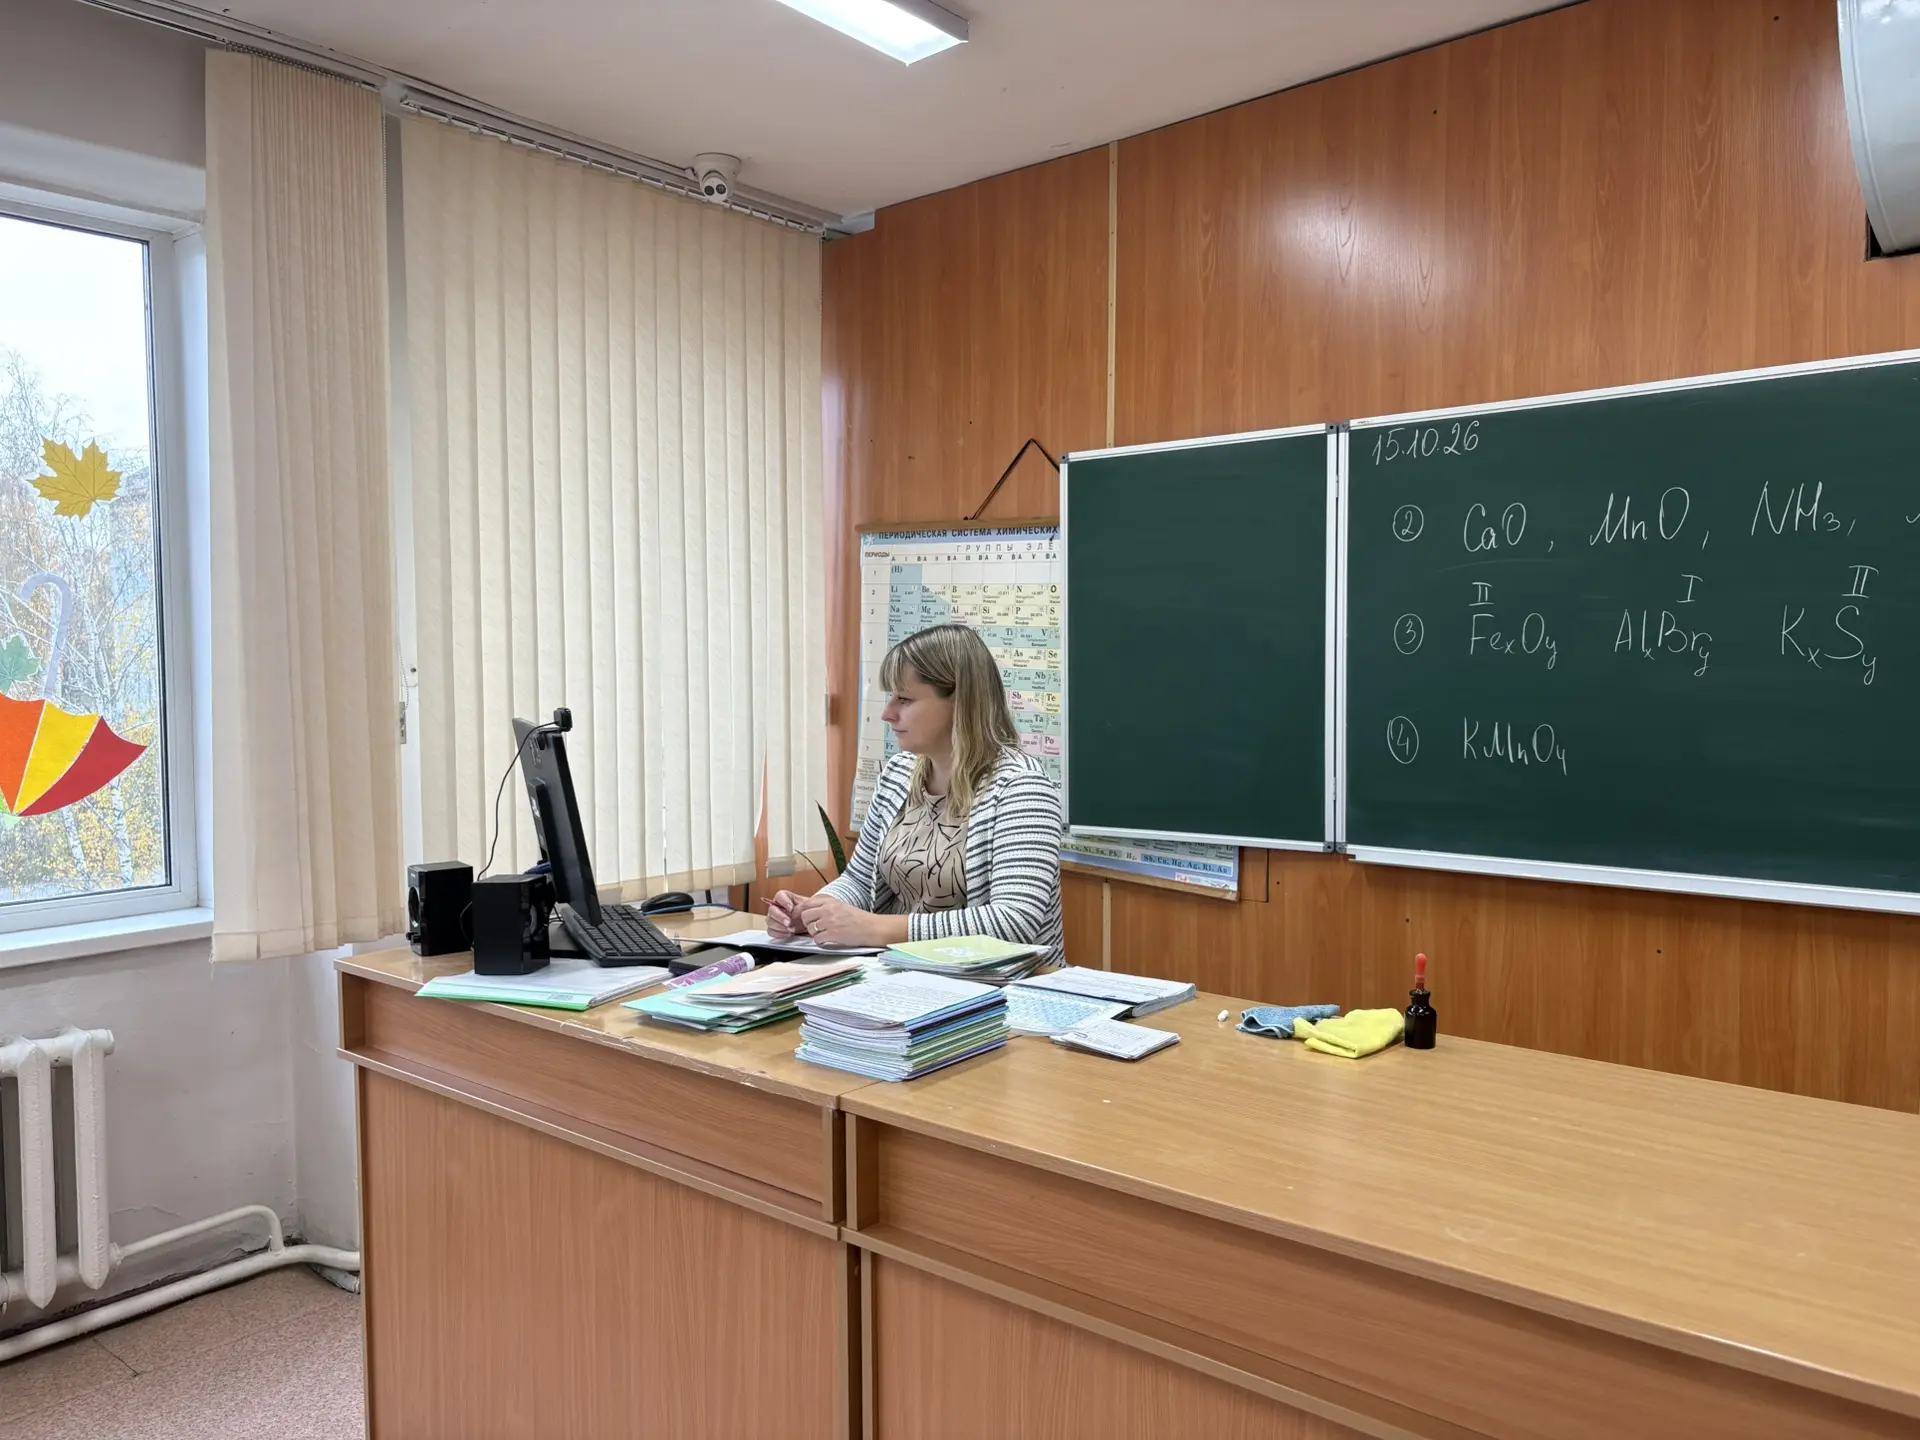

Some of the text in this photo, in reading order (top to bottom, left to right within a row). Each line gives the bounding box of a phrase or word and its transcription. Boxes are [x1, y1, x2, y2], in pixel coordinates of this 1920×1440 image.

[1371, 420, 1480, 466] 15.10.26
[878, 525, 1059, 541] ПЕРИОДИЧЕСКАЯ СИСТЕМА ХИМИЧЕСКИХ
[1050, 584, 1057, 593] O
[890, 605, 900, 613] Na
[920, 606, 931, 614] Mg
[952, 606, 959, 614] Al
[982, 606, 990, 614] Si
[1016, 606, 1021, 614] P
[1050, 606, 1056, 614] S
[1014, 649, 1024, 657] As
[1048, 650, 1058, 658] Se
[1003, 670, 1012, 678] Zr
[1034, 672, 1046, 680] Nb
[1034, 714, 1044, 722] Ta
